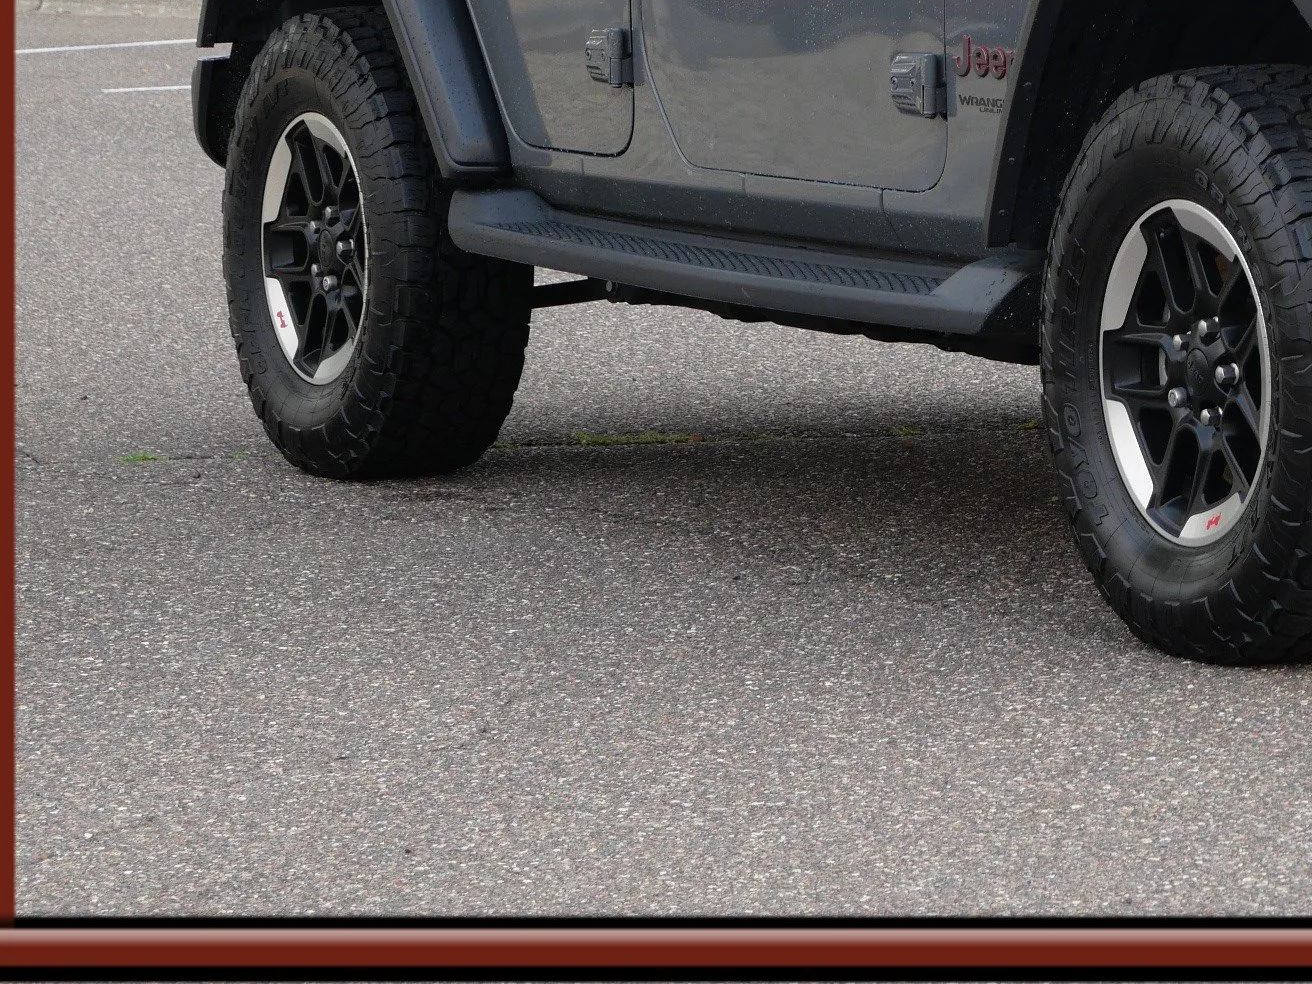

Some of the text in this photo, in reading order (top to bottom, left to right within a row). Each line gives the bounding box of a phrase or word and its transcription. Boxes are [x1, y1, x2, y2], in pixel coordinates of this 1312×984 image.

[952, 34, 1015, 80] Jee
[958, 94, 1005, 108] WRANG
[1061, 402, 1109, 527] TOYO
